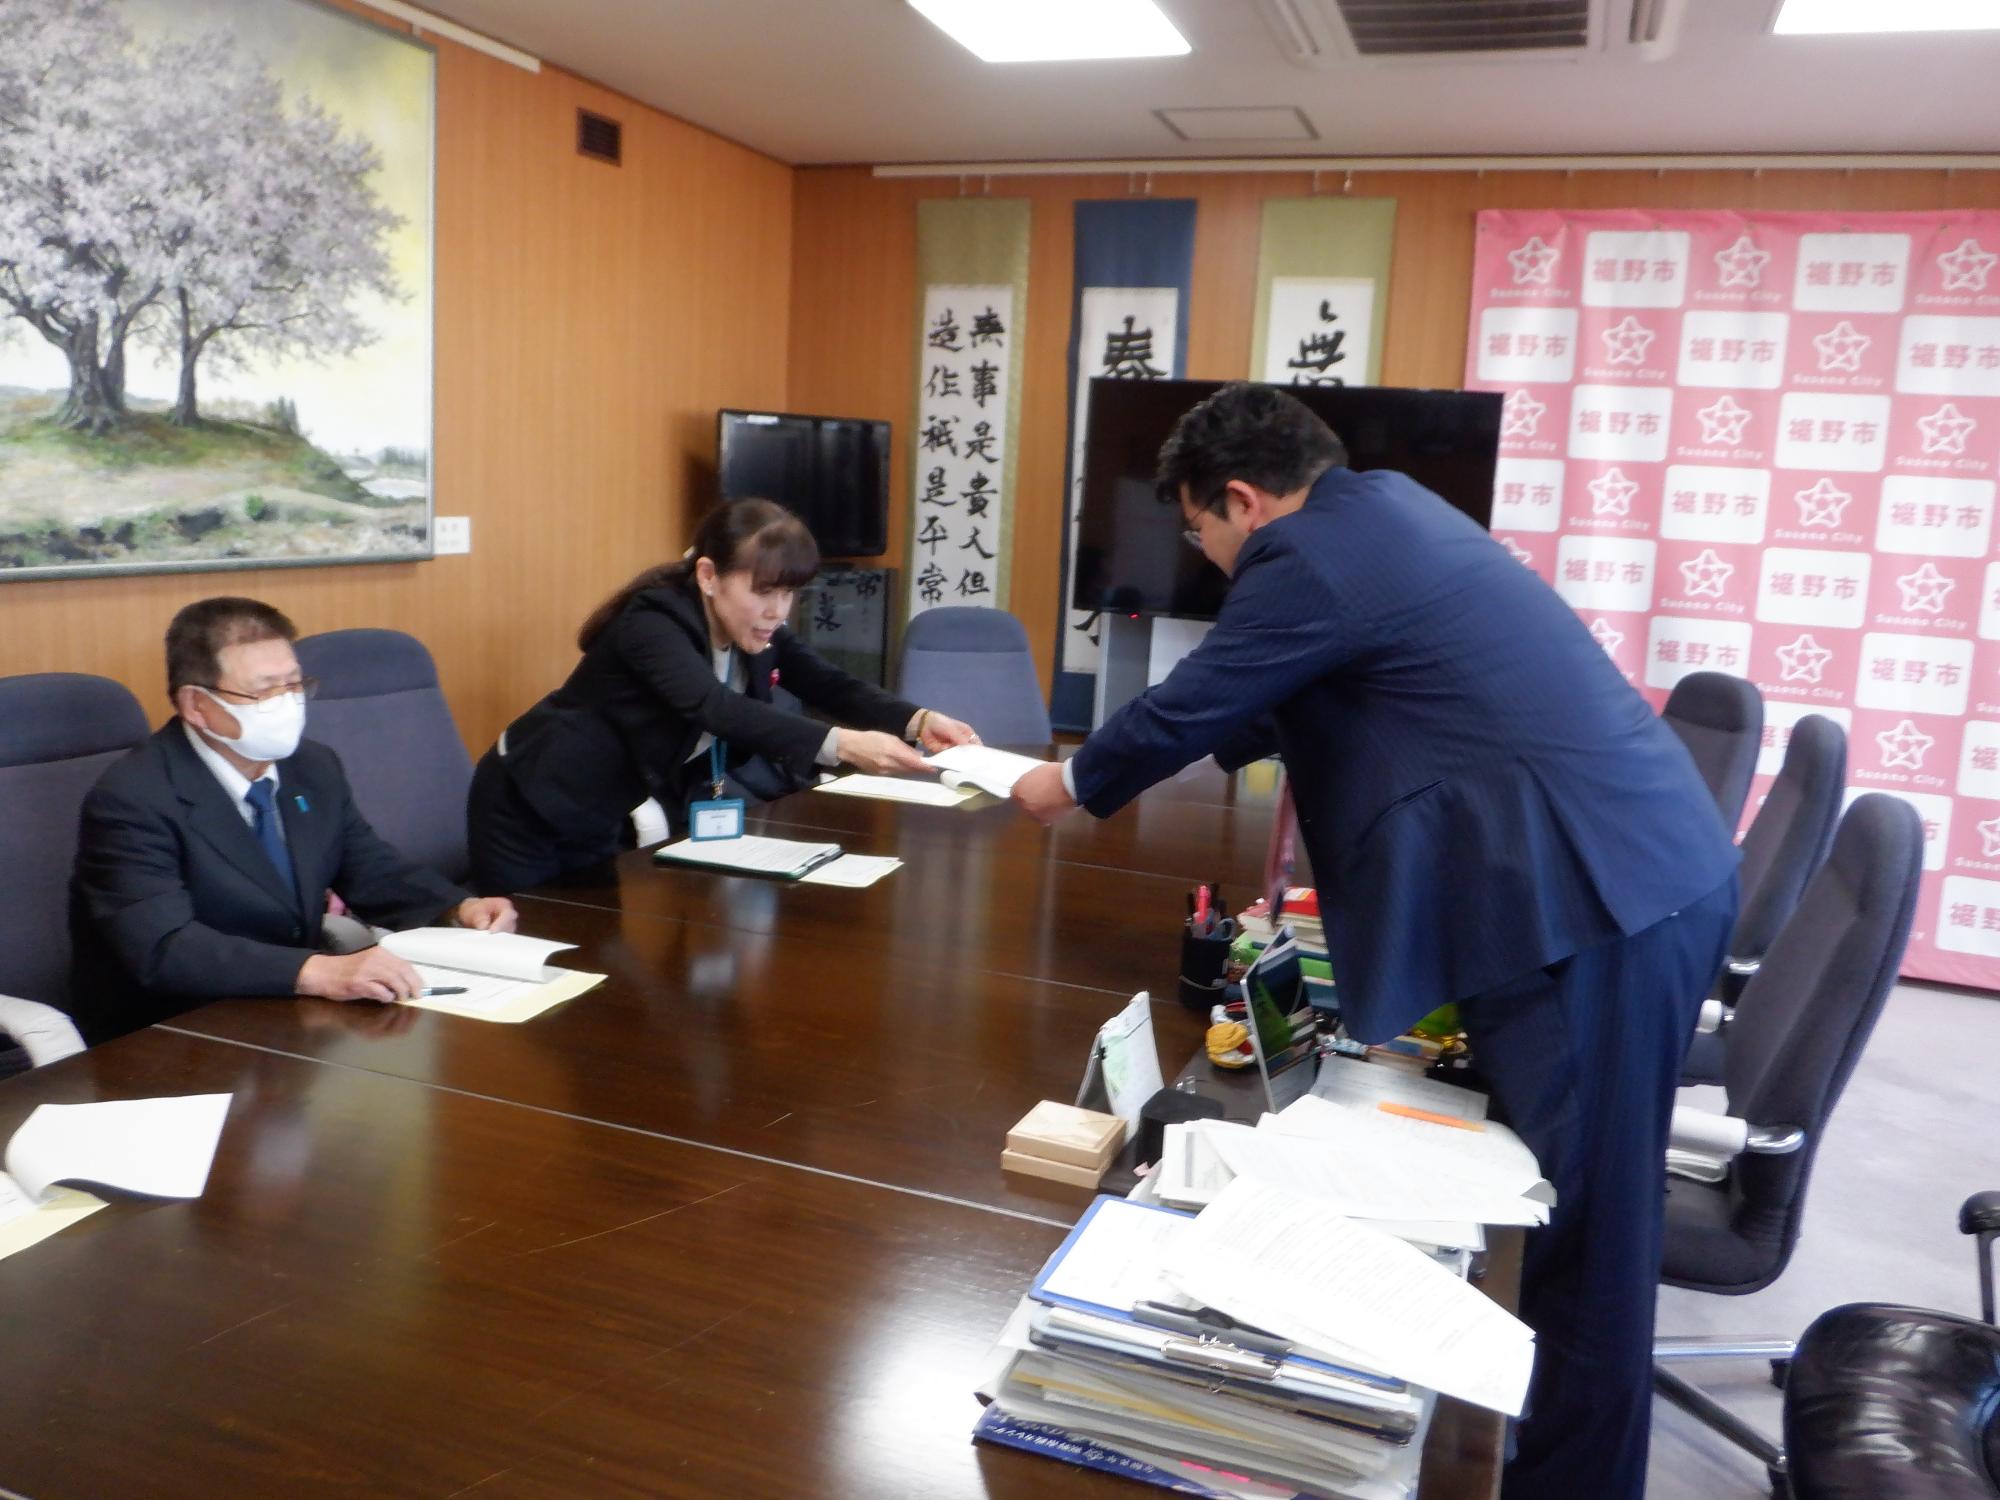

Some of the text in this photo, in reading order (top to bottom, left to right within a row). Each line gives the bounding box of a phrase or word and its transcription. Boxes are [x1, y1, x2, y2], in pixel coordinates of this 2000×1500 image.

[1593, 258, 1677, 283] 裾野市
[1806, 260, 1898, 286] 裾野市
[1488, 333, 1569, 358] 裾野市
[1690, 338, 1776, 363] 裾野市
[1578, 410, 1660, 435] 裾野市
[1788, 418, 1878, 445] 裾野市
[1502, 482, 1554, 506] 野市
[1672, 490, 1759, 516] 裾野市
[1890, 502, 1983, 530] 裾野市
[1565, 559, 1645, 584] 裾野市
[1770, 571, 1858, 600] 裾野市
[1656, 639, 1738, 666] 裾野市
[1871, 656, 1962, 686] 裾野市
[1951, 902, 2000, 931] 裾野
